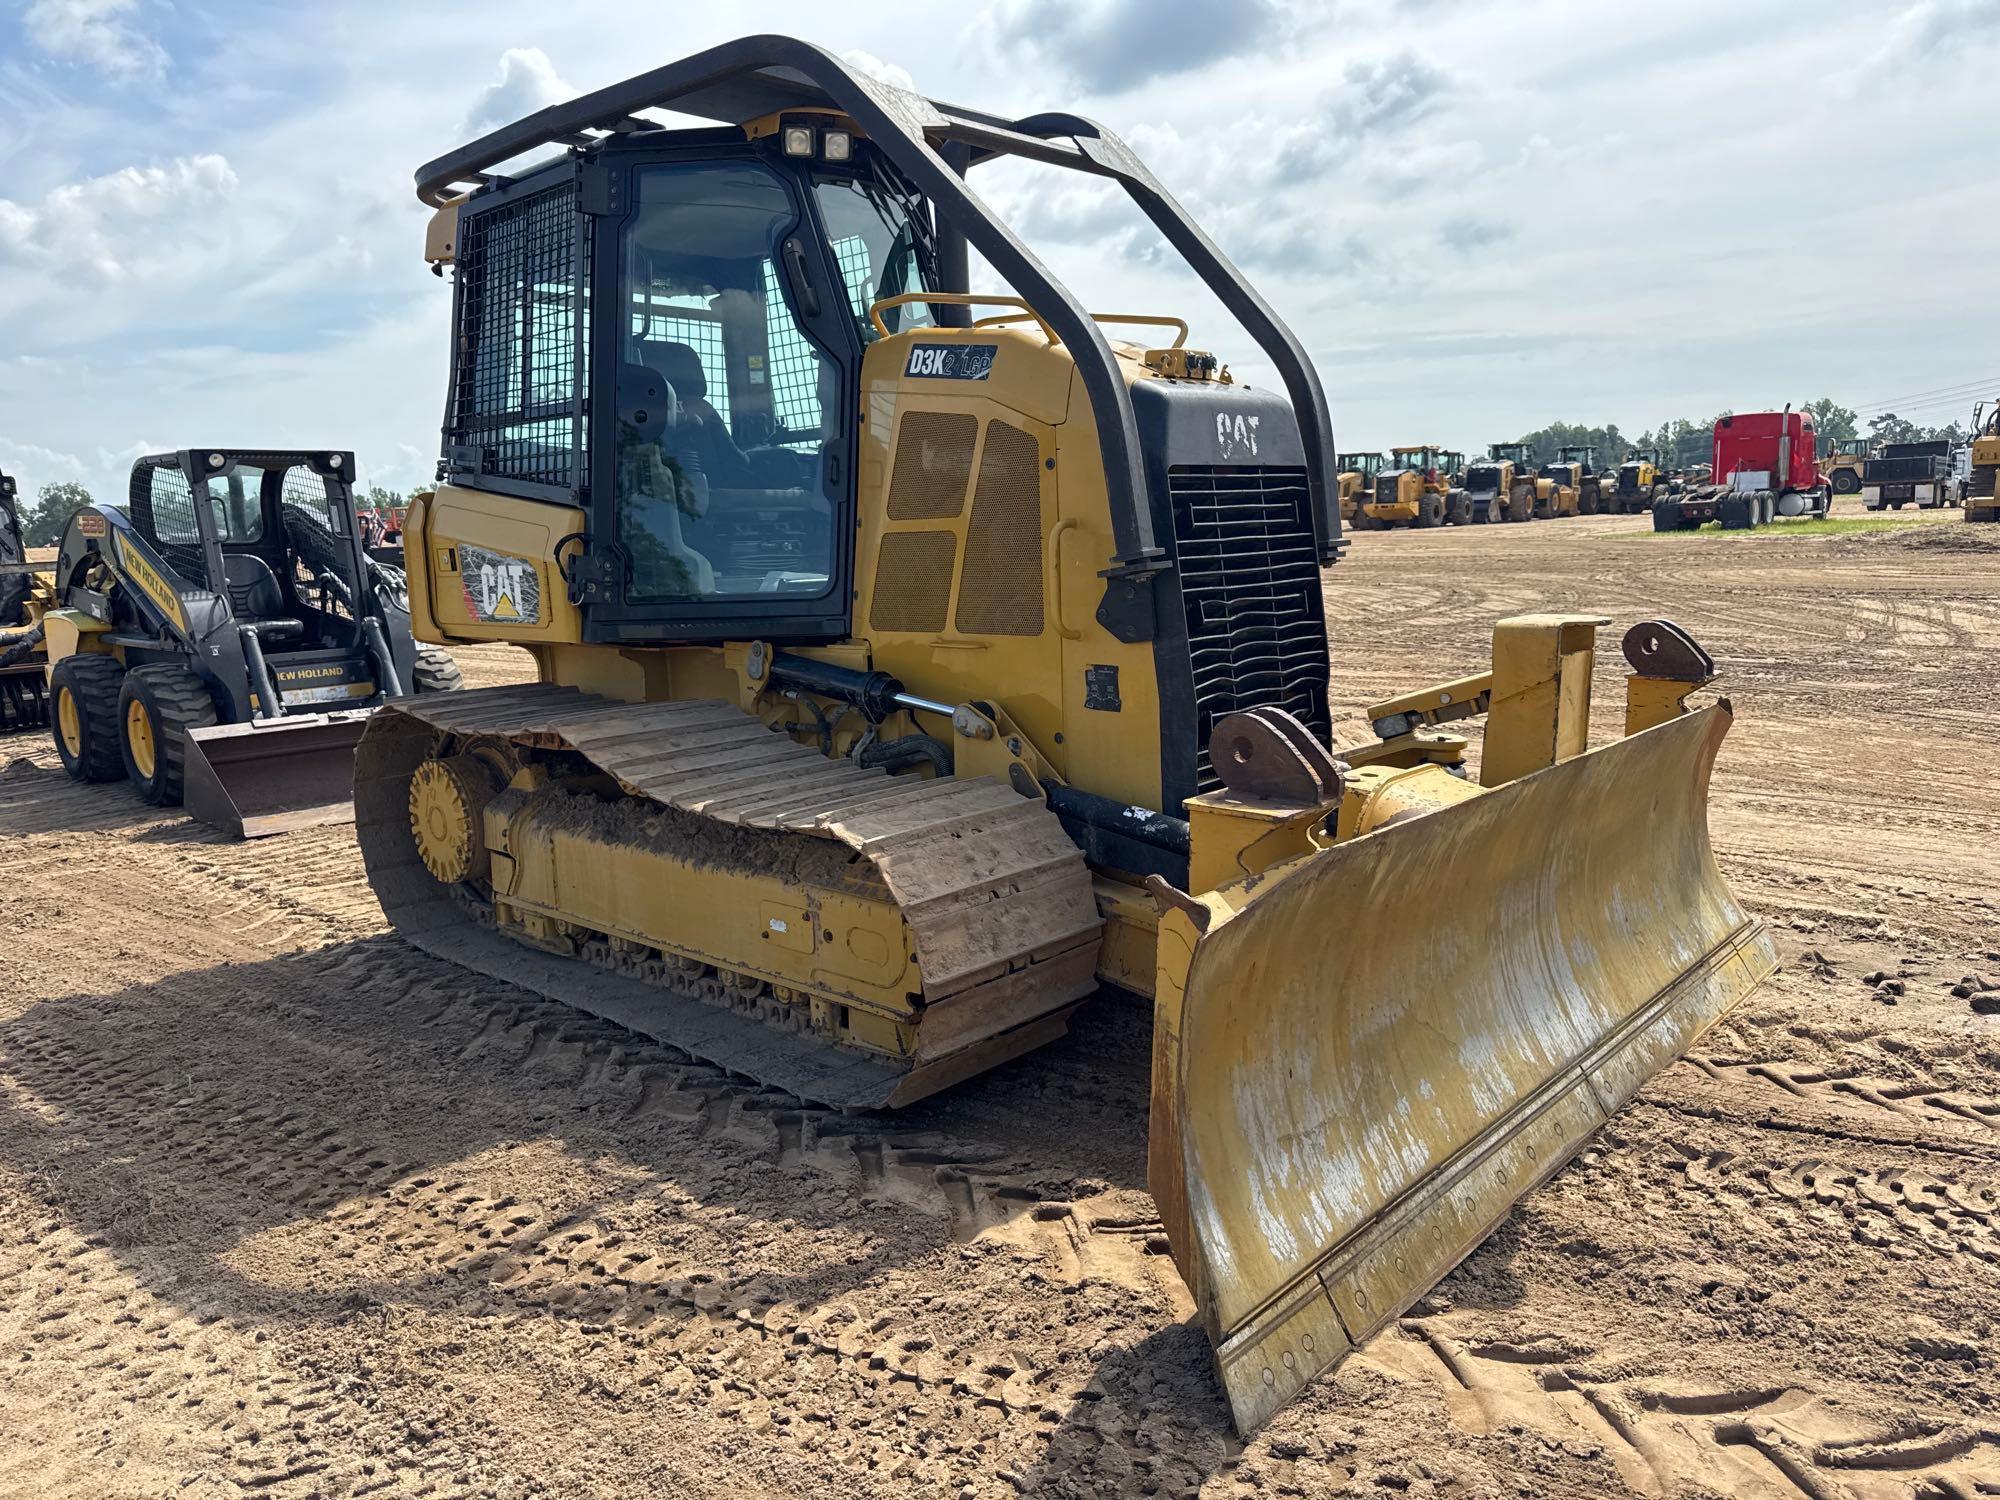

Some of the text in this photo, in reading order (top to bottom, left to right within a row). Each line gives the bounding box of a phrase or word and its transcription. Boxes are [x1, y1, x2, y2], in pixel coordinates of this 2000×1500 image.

[126, 548, 175, 611] NEW HOLLAND
[481, 564, 523, 616] CAT
[297, 667, 344, 679] HOLLAND
